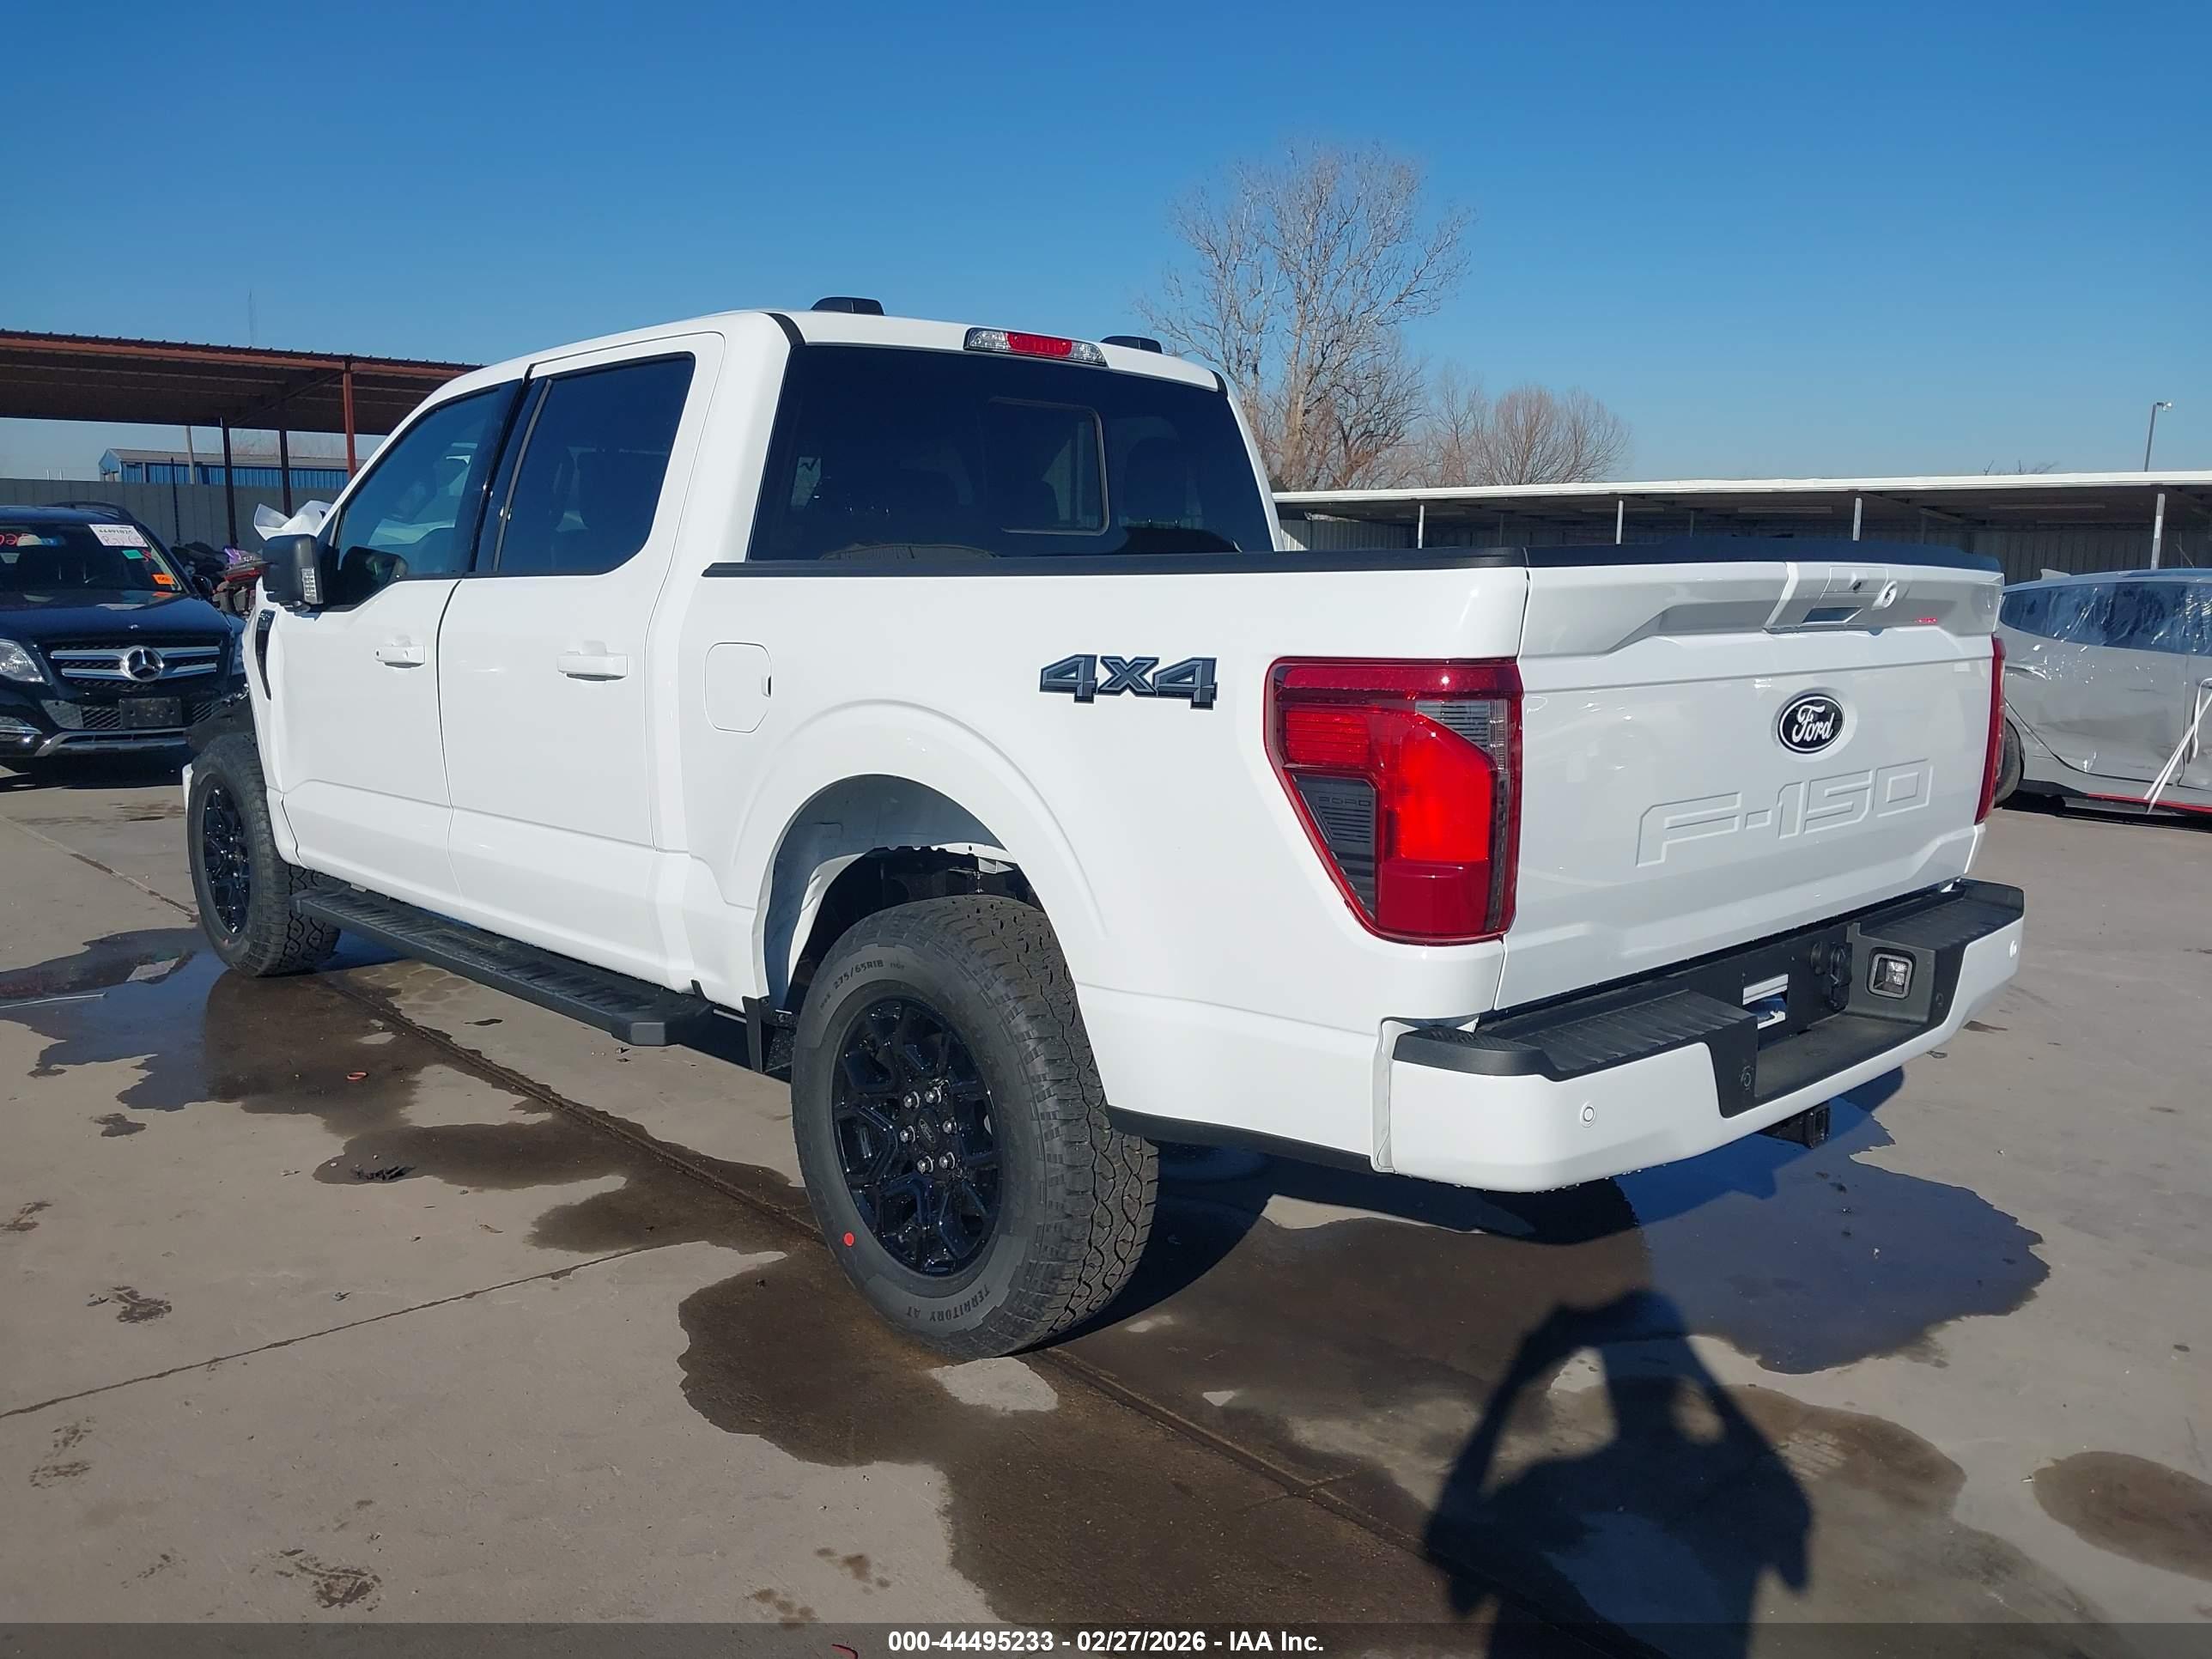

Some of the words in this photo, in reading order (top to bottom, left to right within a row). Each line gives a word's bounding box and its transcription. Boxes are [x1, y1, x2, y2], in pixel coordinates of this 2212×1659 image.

[1792, 704, 1835, 744] Ford
[1636, 758, 1934, 867] F-150
[907, 1306, 921, 1319] AT
[929, 1284, 990, 1322] TERRITORY
